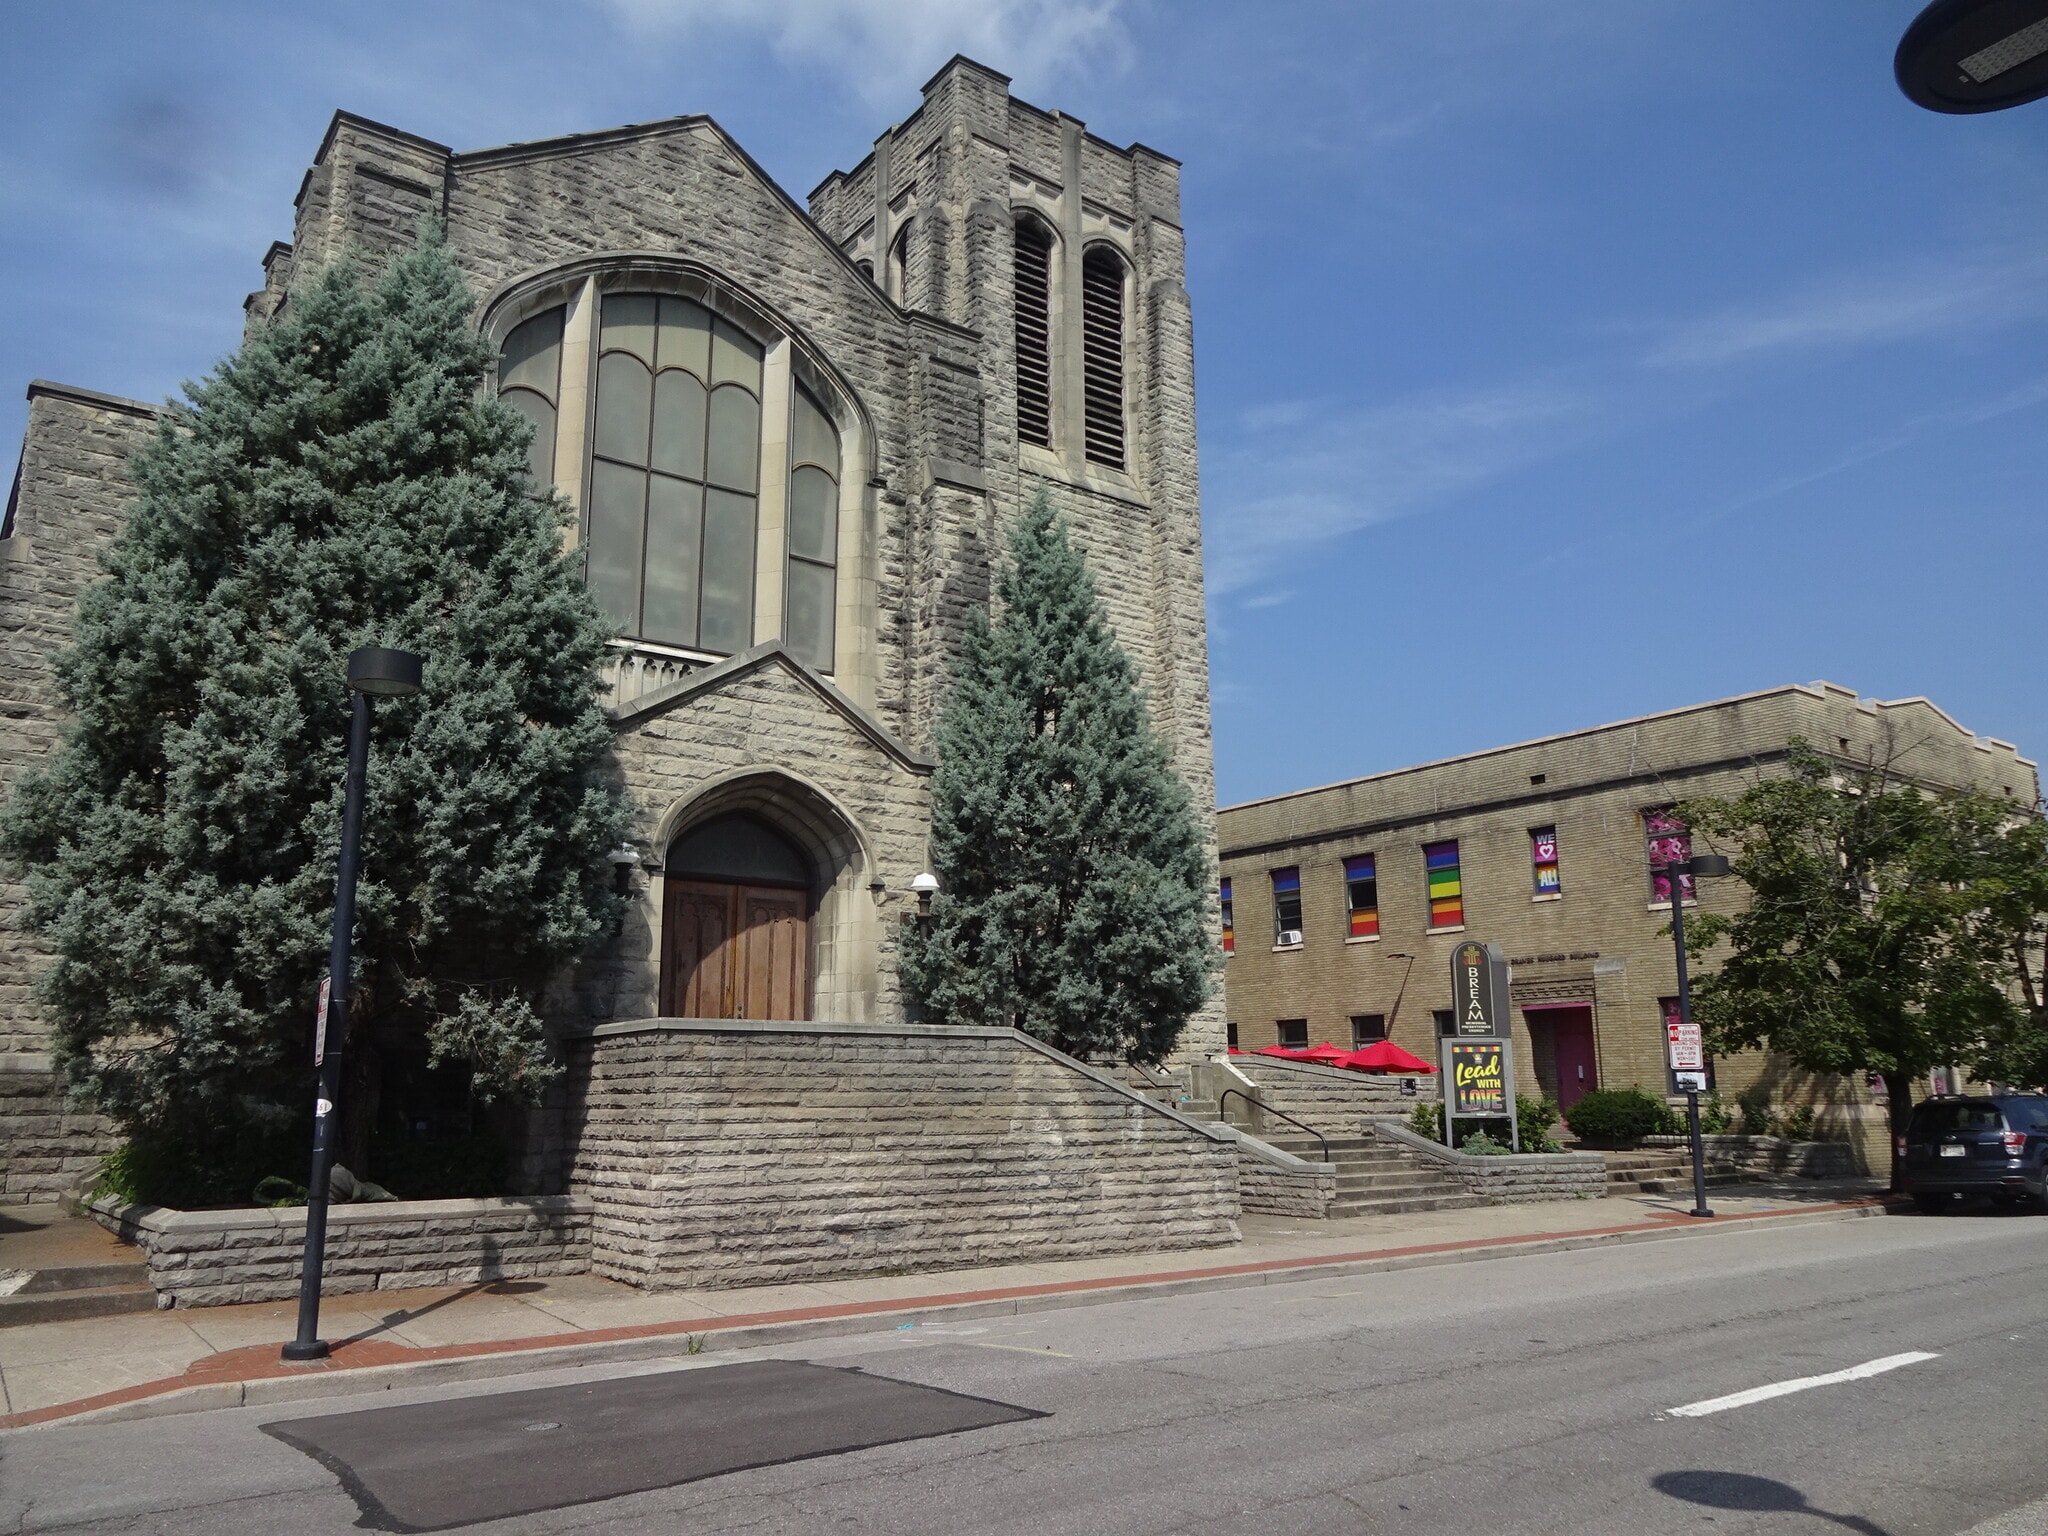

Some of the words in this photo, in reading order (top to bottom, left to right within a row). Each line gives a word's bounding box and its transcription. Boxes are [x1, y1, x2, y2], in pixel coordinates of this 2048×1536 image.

[1536, 834, 1555, 845] WE
[1540, 869, 1558, 887] ALL
[1468, 967, 1484, 1020] BREAM
[1456, 1055, 1501, 1087] Lead
[1476, 1079, 1501, 1088] WITH
[1460, 1089, 1503, 1110] LOVE
